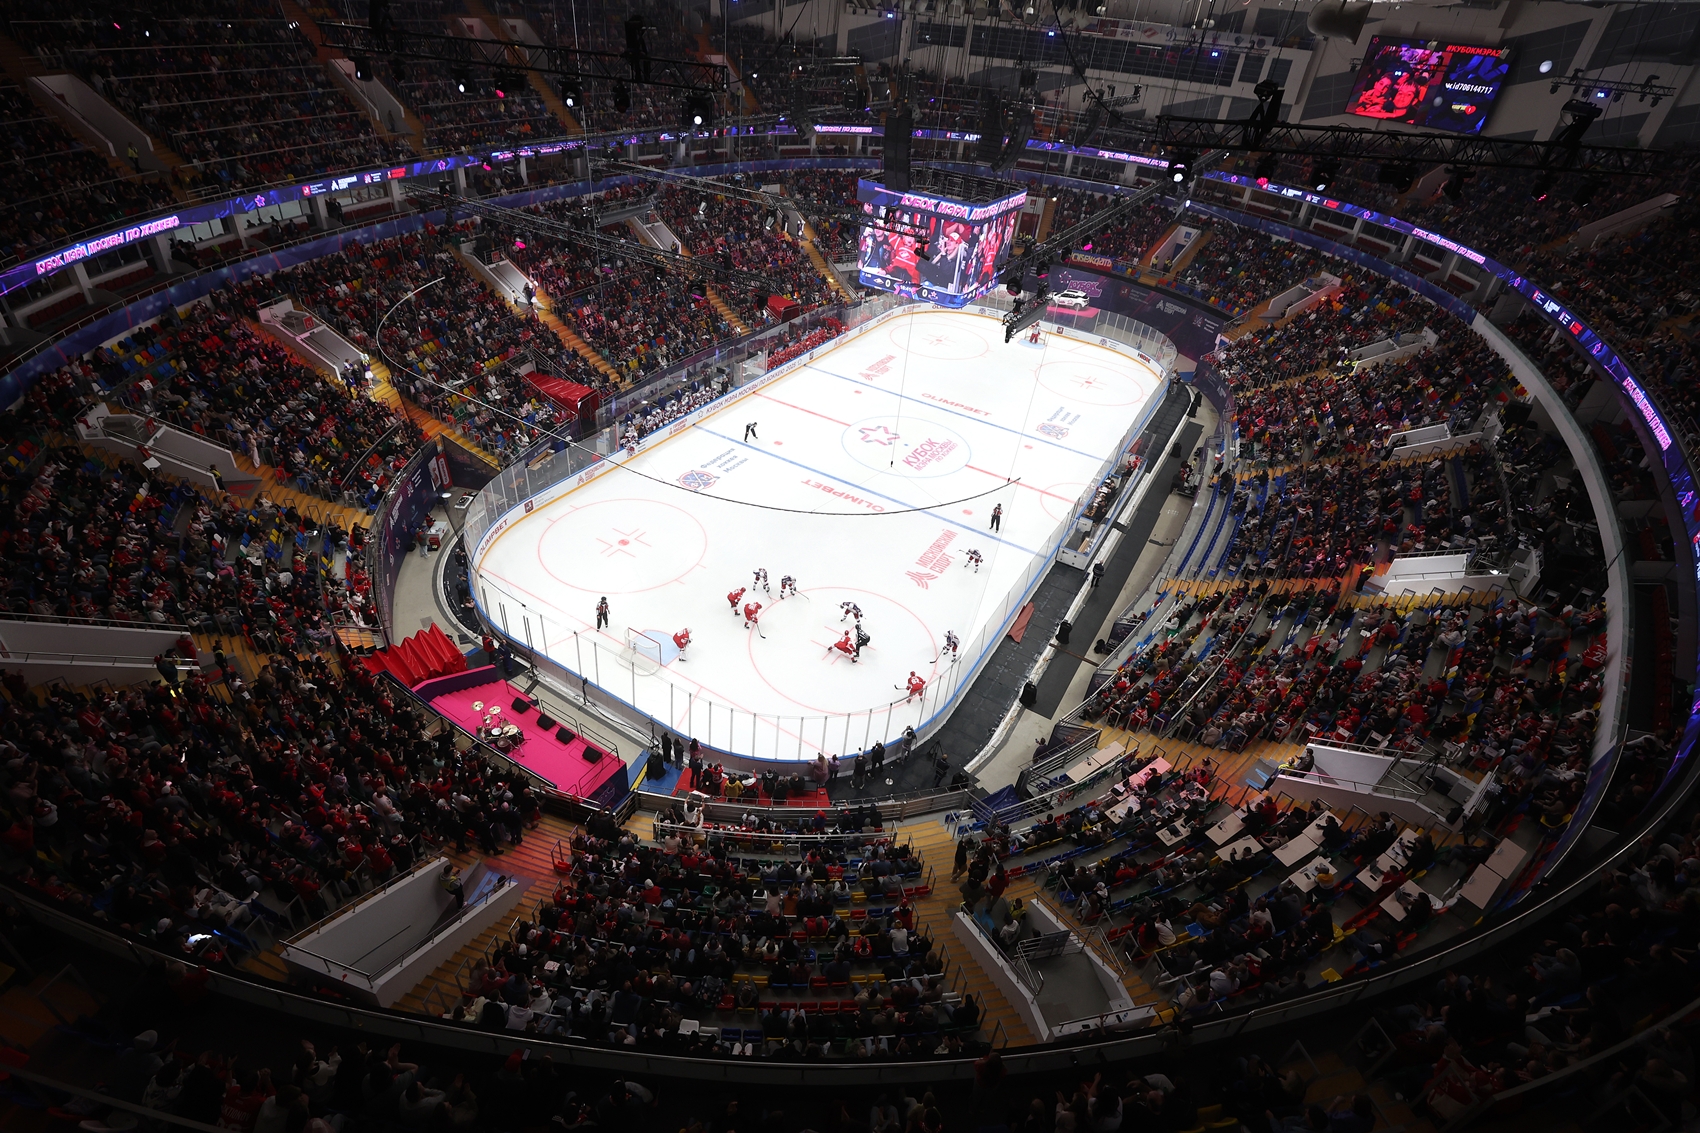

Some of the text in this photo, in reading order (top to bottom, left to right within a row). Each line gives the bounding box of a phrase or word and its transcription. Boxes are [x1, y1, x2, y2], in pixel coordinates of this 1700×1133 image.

[900, 193, 969, 219] КУБОК МЭРА
[35, 215, 180, 275] КУБОК МЭРА МОСКВЫ ПО ХОККЕЮ
[705, 400, 723, 414] КУБОК
[737, 382, 759, 399] МОСКВЫ
[921, 392, 992, 416] OLIMPBET
[902, 438, 940, 467] КУБОК
[914, 438, 953, 471] МЭРА МОСКВЫ
[801, 478, 886, 513] OLIMPBET
[479, 518, 509, 556] OLIMPBET
[915, 528, 959, 569] МОСКОВСКИЙ
[929, 552, 956, 574] СПОРТ
